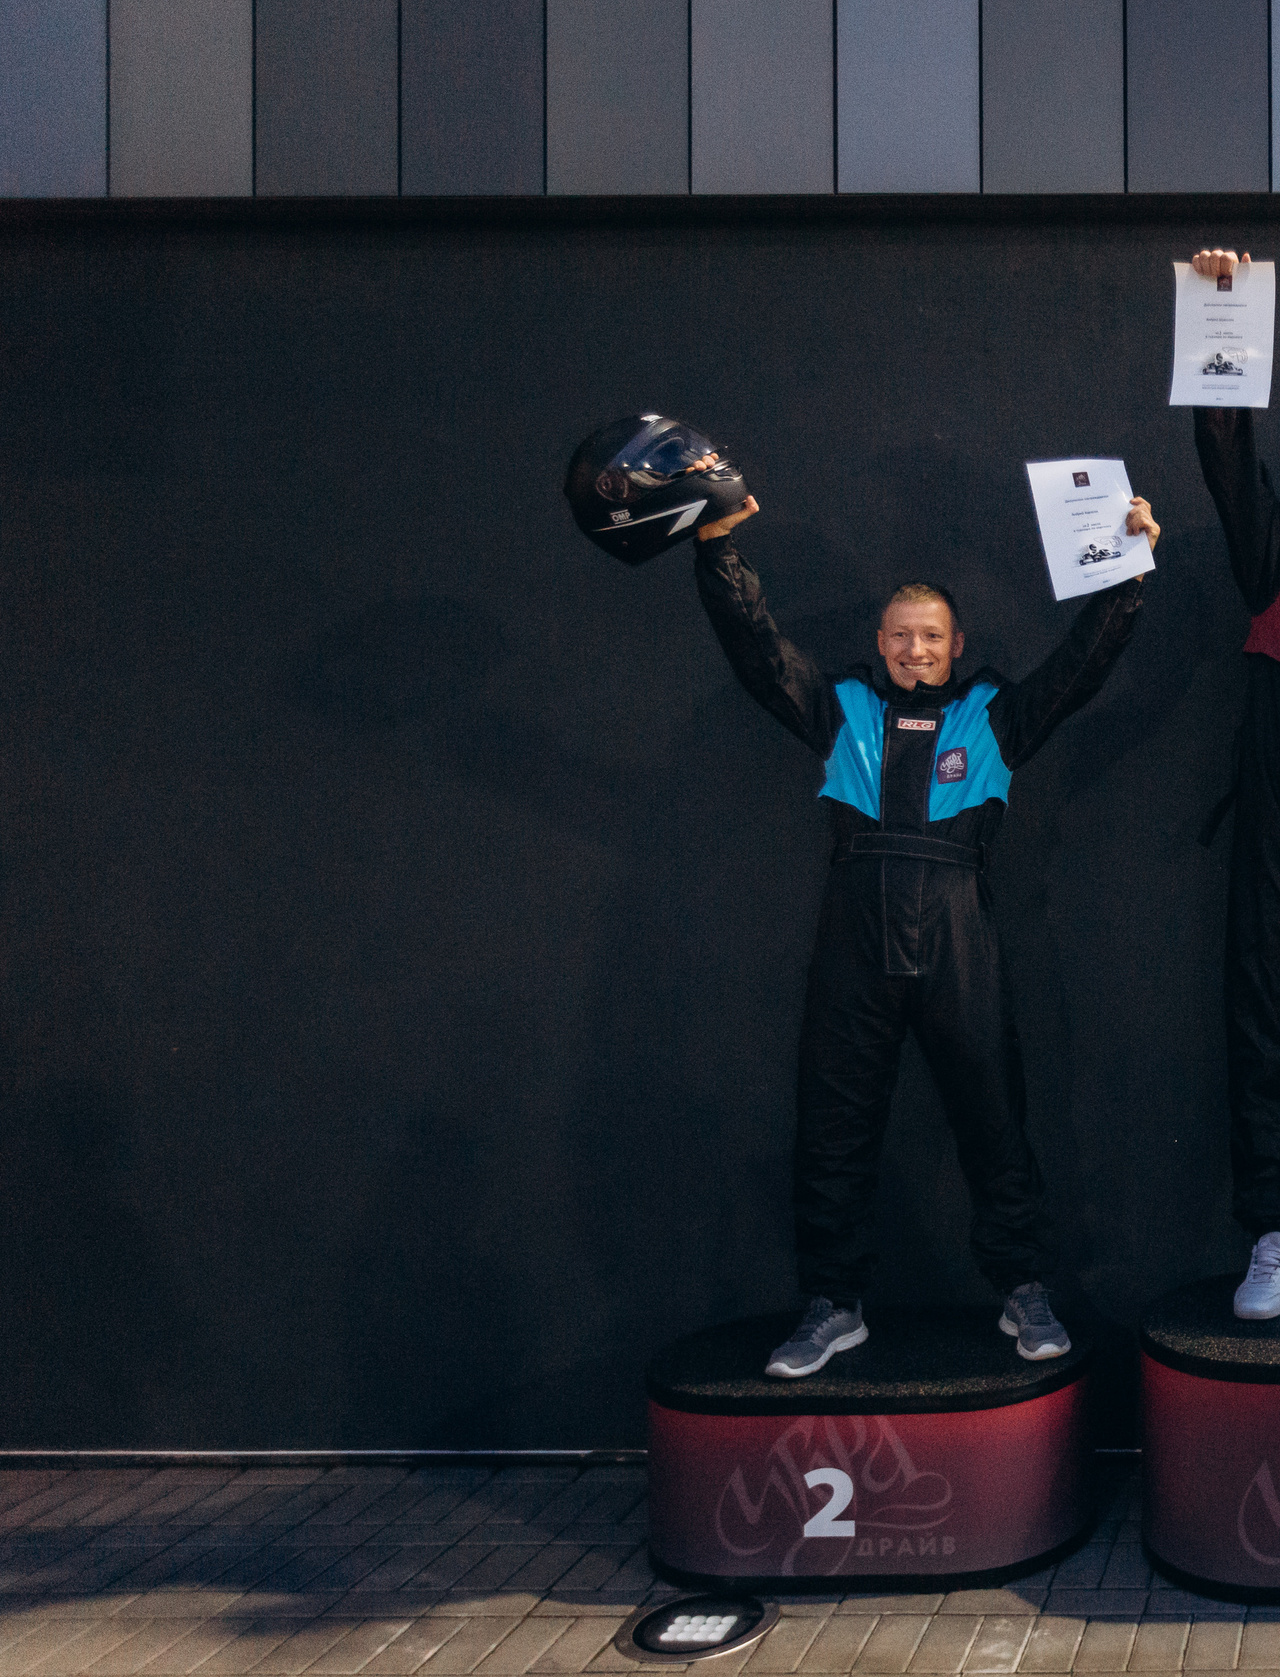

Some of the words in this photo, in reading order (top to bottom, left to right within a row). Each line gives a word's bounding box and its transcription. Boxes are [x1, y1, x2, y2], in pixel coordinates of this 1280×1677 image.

[612, 511, 631, 522] OMP
[901, 720, 933, 729] RLG
[803, 1467, 856, 1538] 2
[855, 1531, 957, 1557] ДРАЙВ
